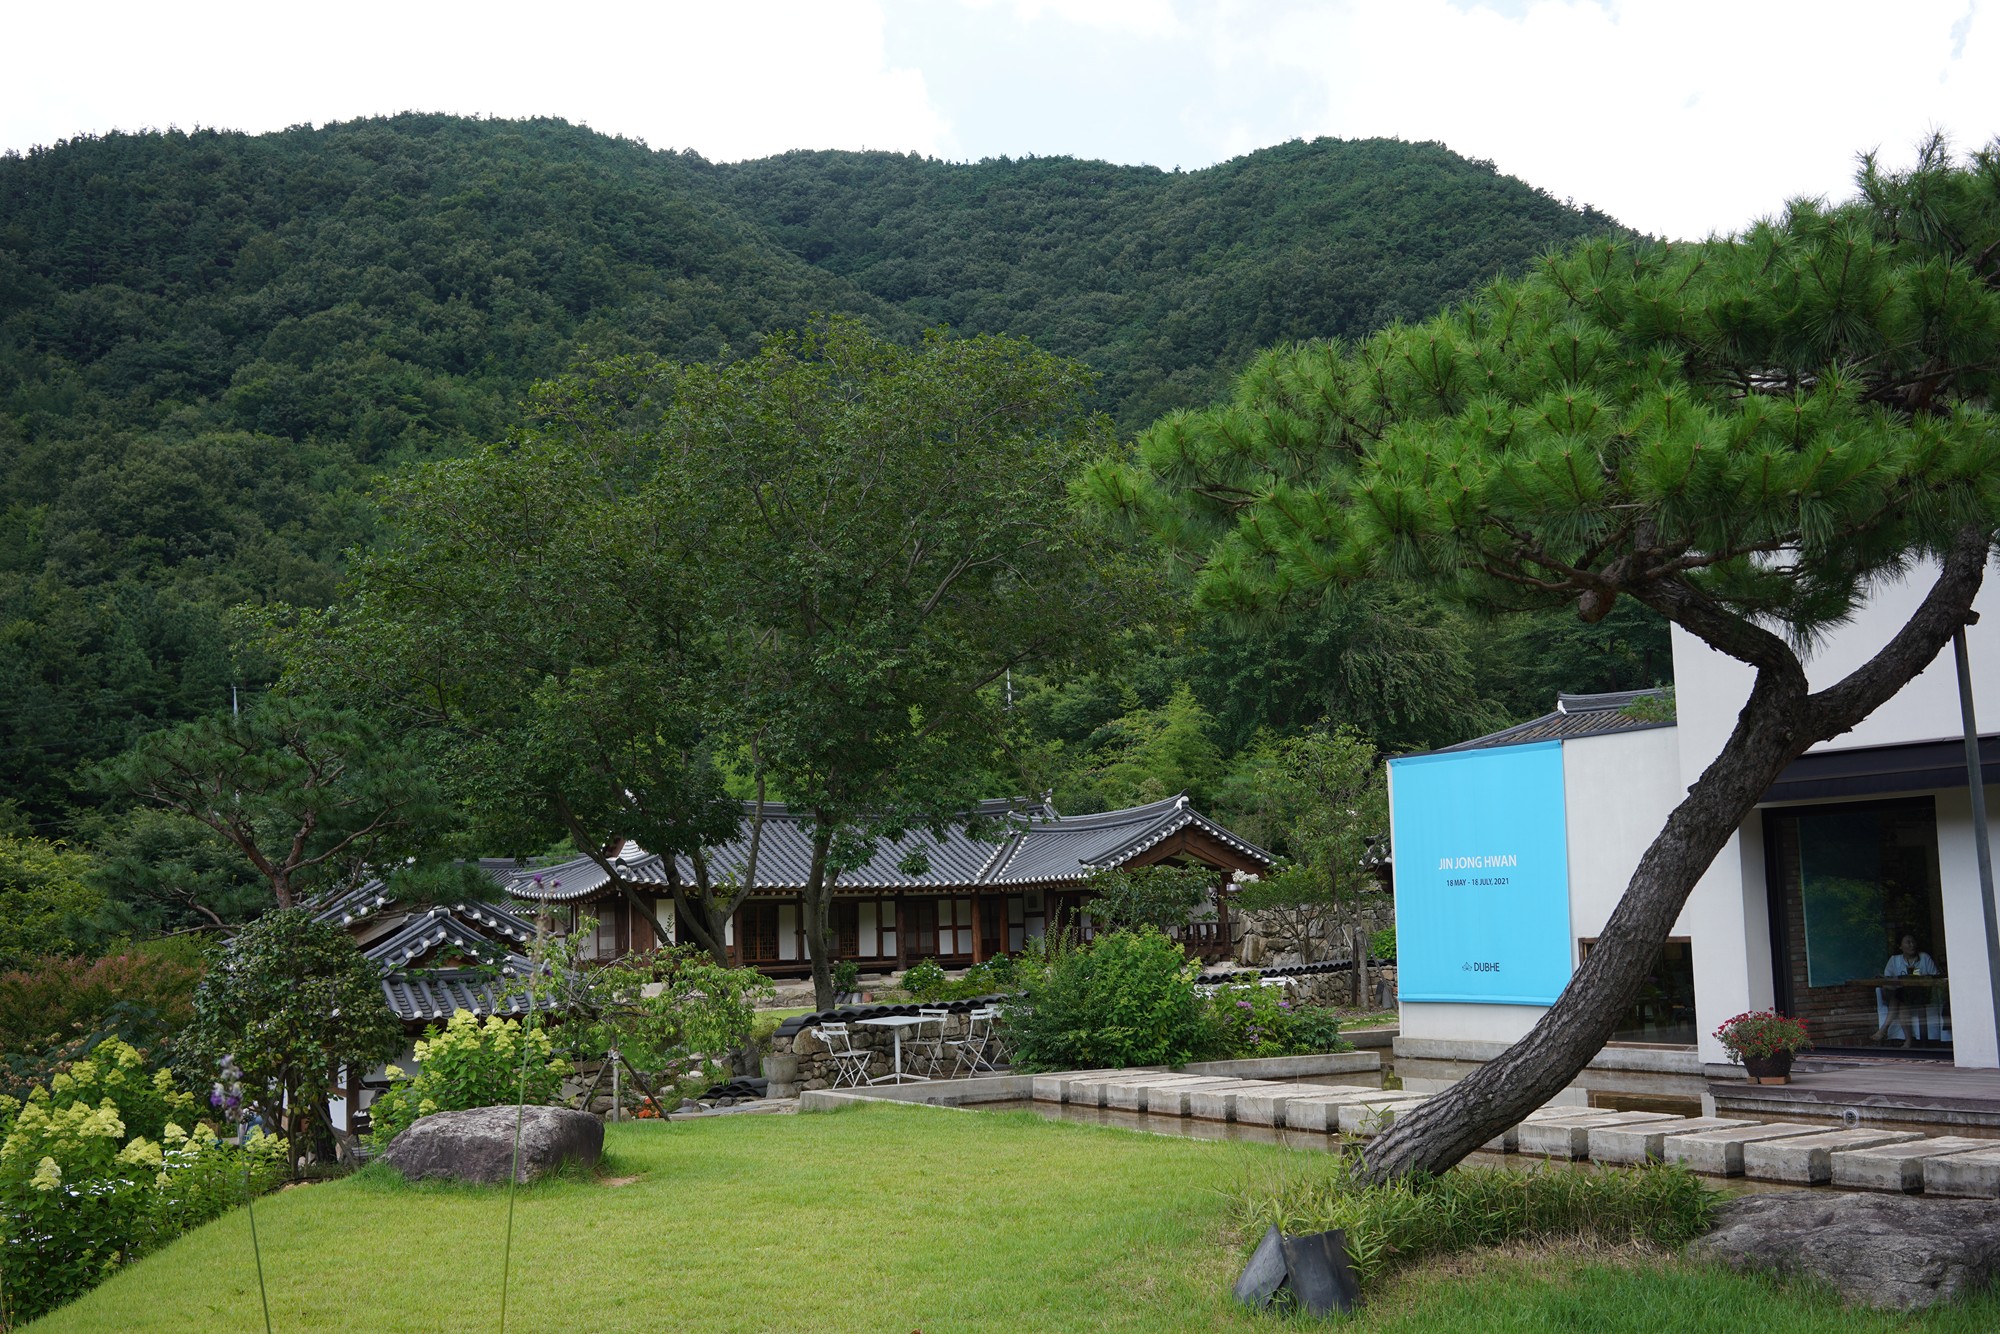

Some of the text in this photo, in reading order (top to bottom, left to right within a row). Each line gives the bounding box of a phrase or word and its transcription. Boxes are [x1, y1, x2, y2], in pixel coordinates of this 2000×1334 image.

[1439, 854, 1516, 870] JIN JONG HWAN
[1474, 962, 1500, 972] DUBHE
